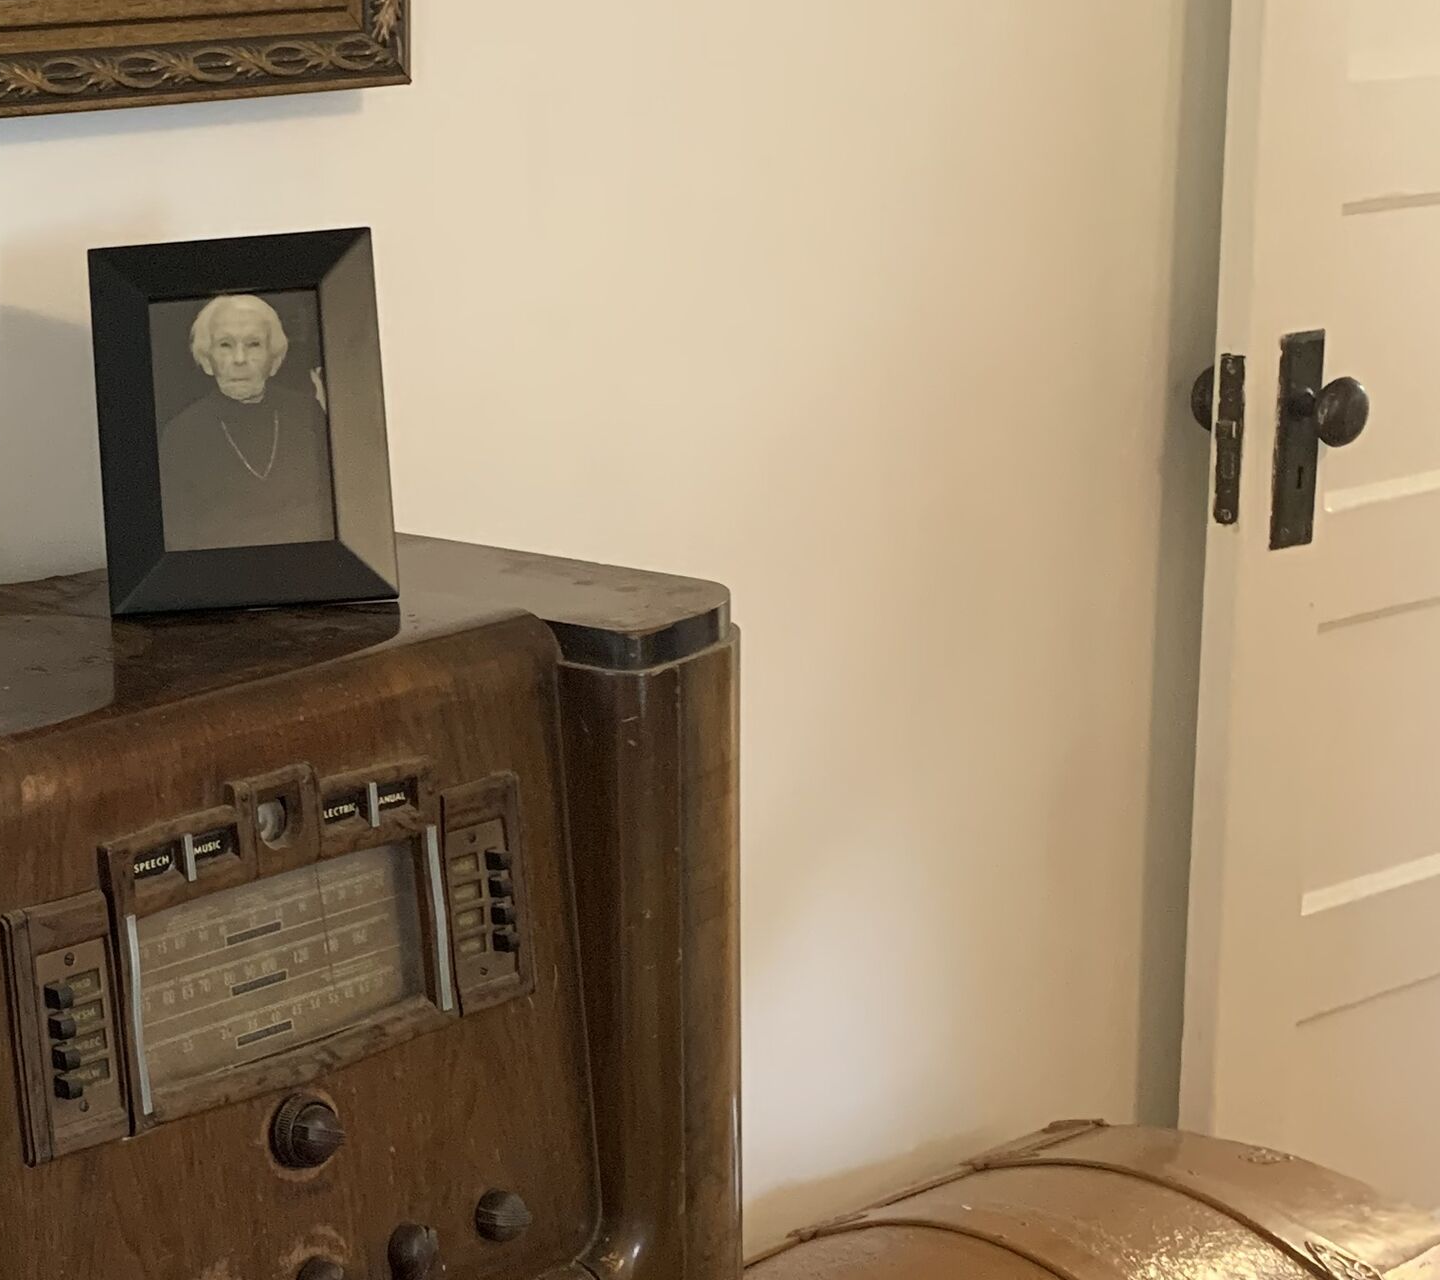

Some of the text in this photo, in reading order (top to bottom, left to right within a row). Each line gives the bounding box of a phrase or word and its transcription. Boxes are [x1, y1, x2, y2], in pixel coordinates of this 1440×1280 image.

[378, 791, 406, 805] ANUAL
[194, 840, 221, 856] MUSIC
[134, 855, 170, 874] SPEECH
